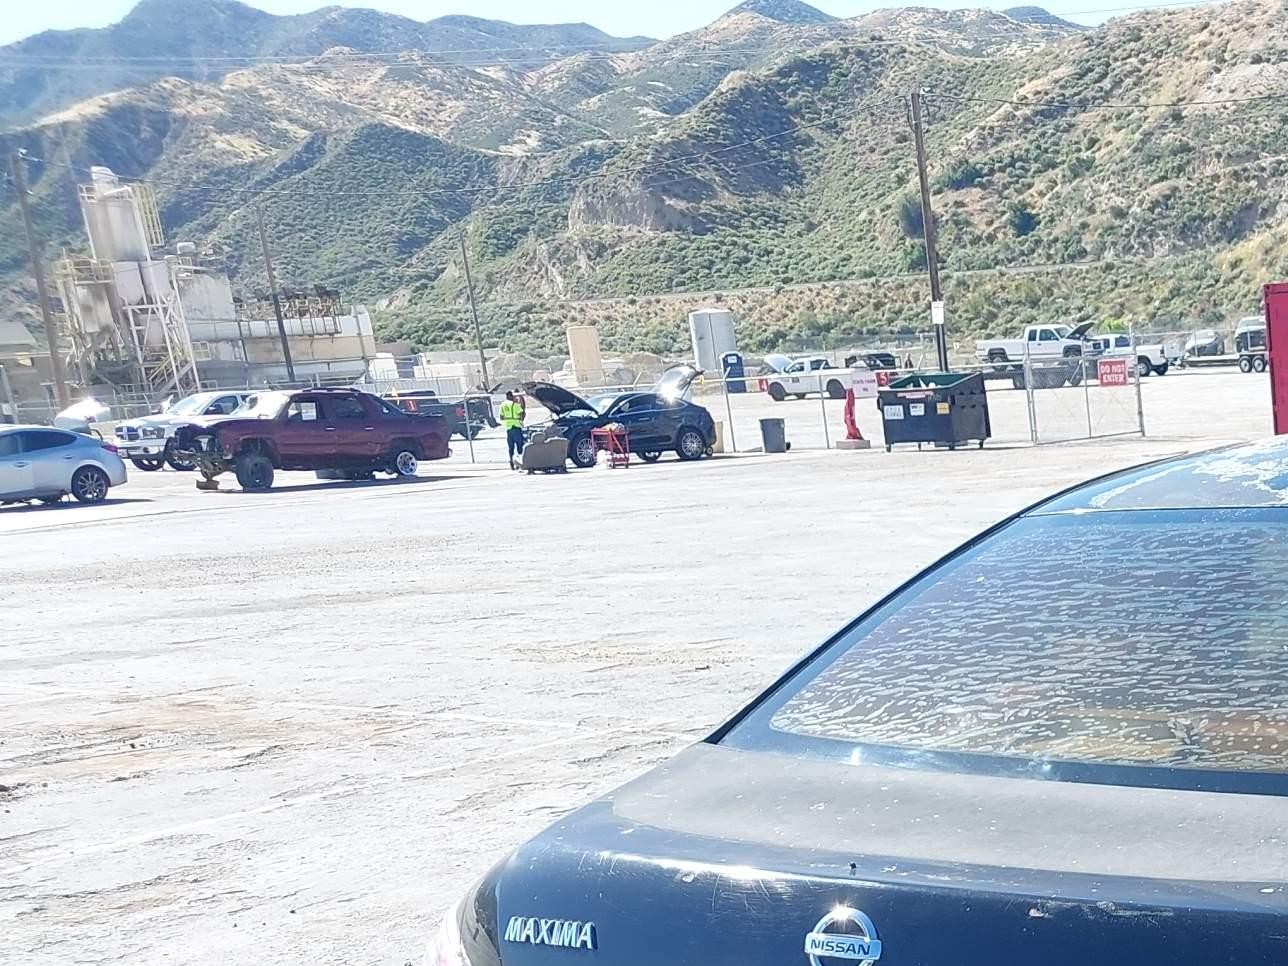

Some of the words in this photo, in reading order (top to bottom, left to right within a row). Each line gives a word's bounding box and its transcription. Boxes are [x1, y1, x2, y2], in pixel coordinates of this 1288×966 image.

[1100, 363, 1110, 374] DO
[1111, 363, 1125, 374] NOT
[879, 373, 888, 384] 5
[1103, 374, 1124, 383] ENTER
[504, 916, 597, 950] MAXIMA
[810, 938, 871, 956] NISSAN
